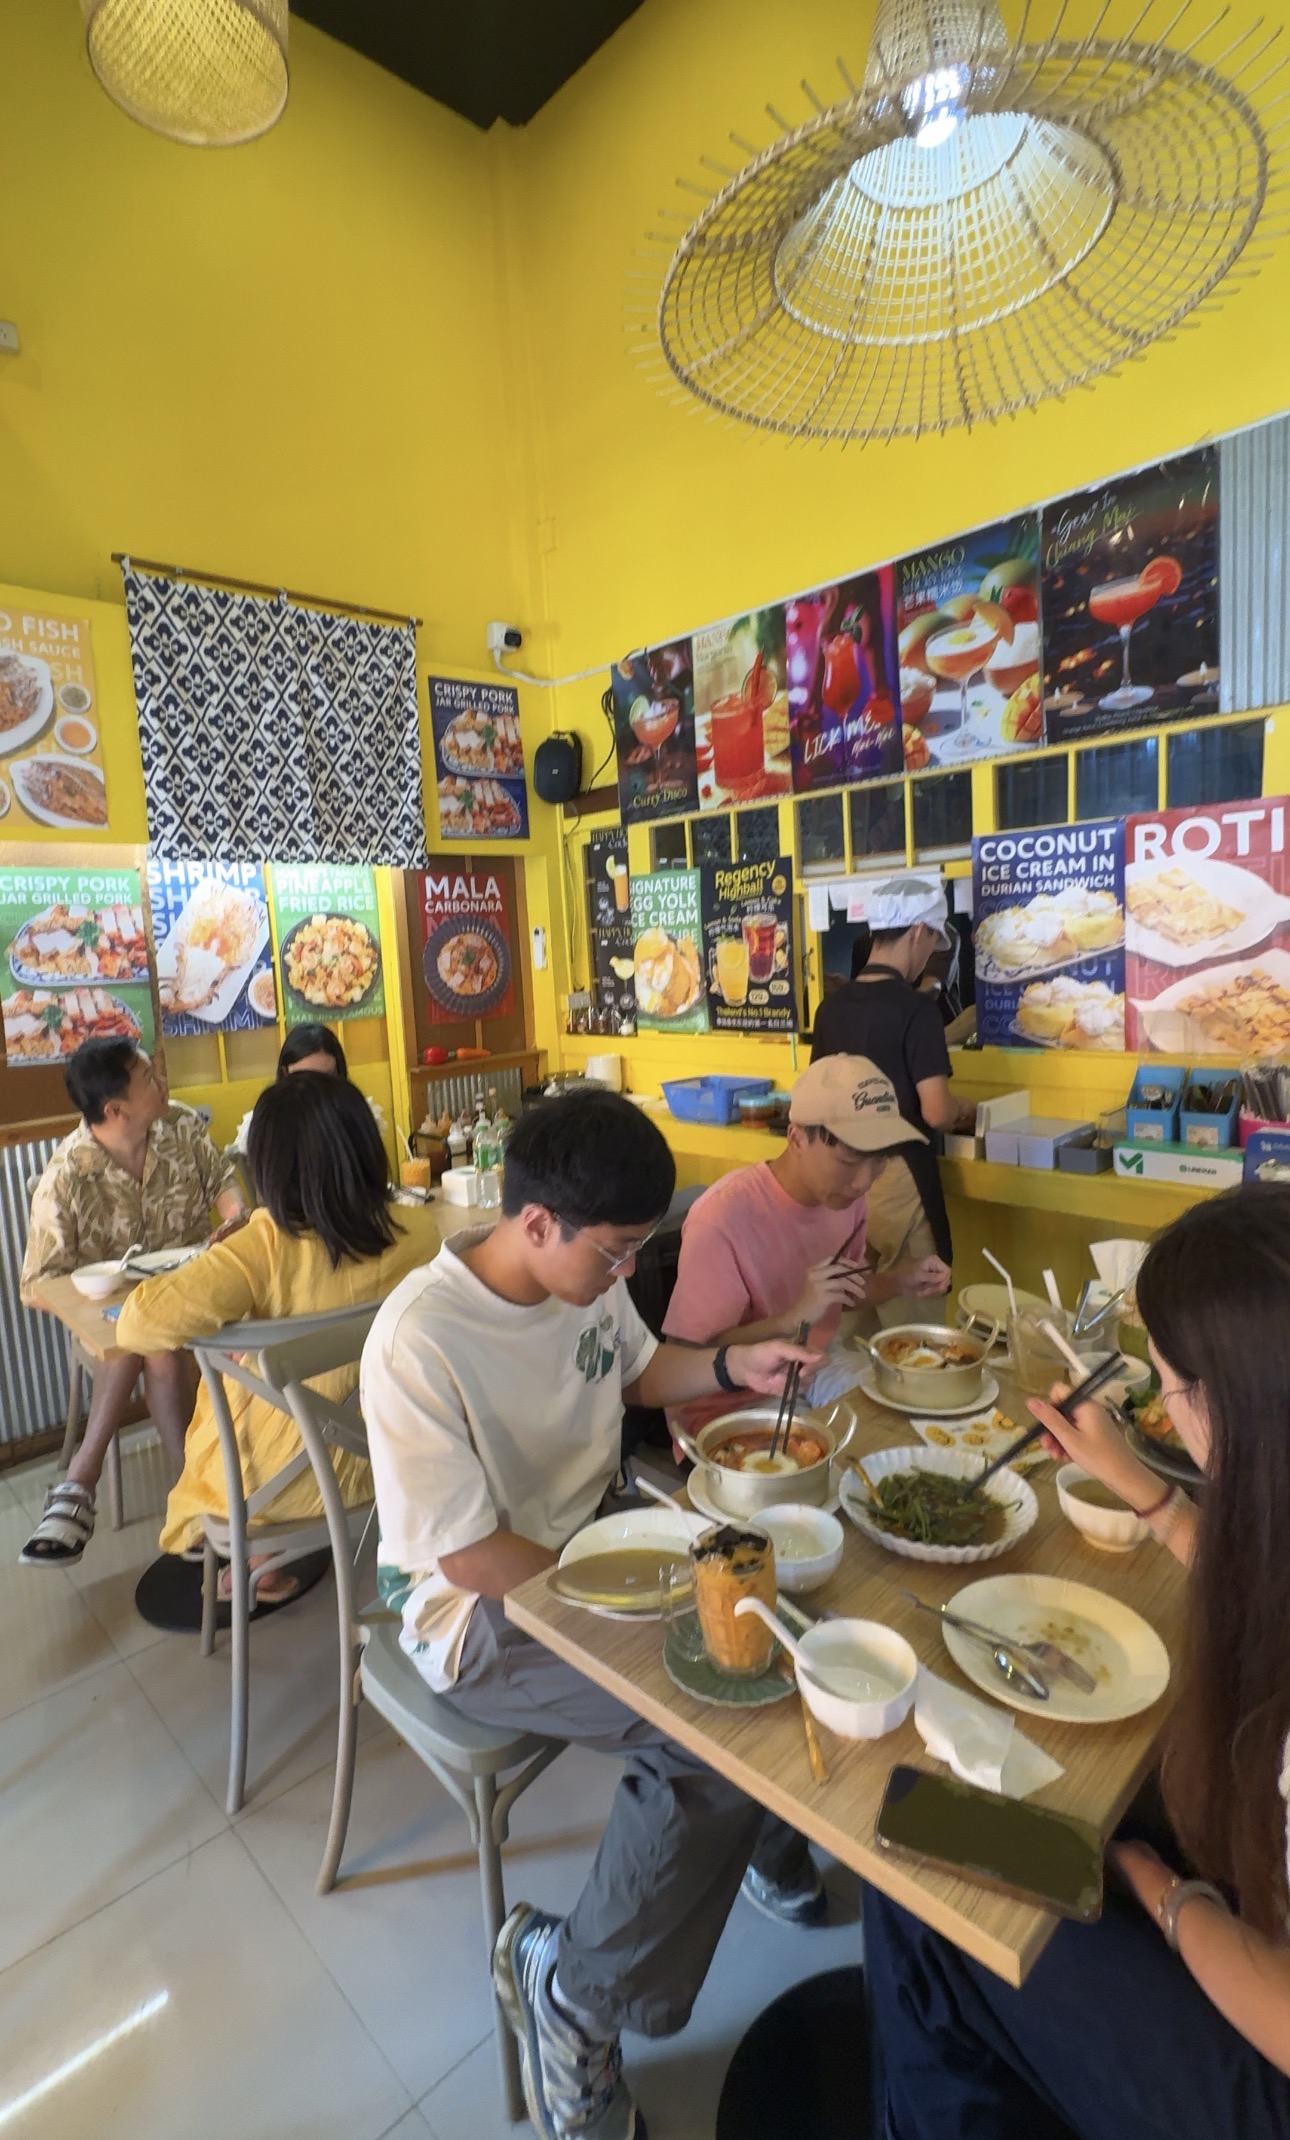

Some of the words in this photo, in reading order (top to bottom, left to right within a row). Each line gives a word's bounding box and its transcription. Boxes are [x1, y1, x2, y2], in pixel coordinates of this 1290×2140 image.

[902, 544, 966, 580] MANGO
[22, 615, 79, 642] FISH
[29, 641, 81, 659] SAUCE
[434, 682, 477, 700] CRISPY
[481, 688, 513, 704] PORK
[454, 698, 491, 712] GRILLED
[492, 703, 514, 716] PORK
[980, 828, 1117, 863] COCONUT
[1134, 807, 1285, 865] ROTI
[148, 861, 257, 886] SHRIMP
[714, 859, 776, 890] Regency
[982, 863, 1010, 882] ICE
[1016, 857, 1086, 879] CREAM
[1092, 853, 1115, 871] IN
[0, 875, 71, 892] CRISPY
[77, 876, 131, 892] PORK
[276, 878, 373, 895] PINEAPPLE
[424, 875, 501, 901] MALA
[718, 877, 763, 902] Highball
[981, 881, 1032, 897] DURIAN
[1035, 874, 1115, 893] SANDWICH
[32, 892, 91, 905] GRILLED
[95, 892, 133, 905] PORK
[278, 896, 332, 913] FRIED
[337, 895, 375, 911] RICE
[424, 900, 503, 914] CARBONARA
[631, 895, 654, 912] GG
[658, 891, 698, 909] YOLK
[649, 908, 699, 927] CREAM
